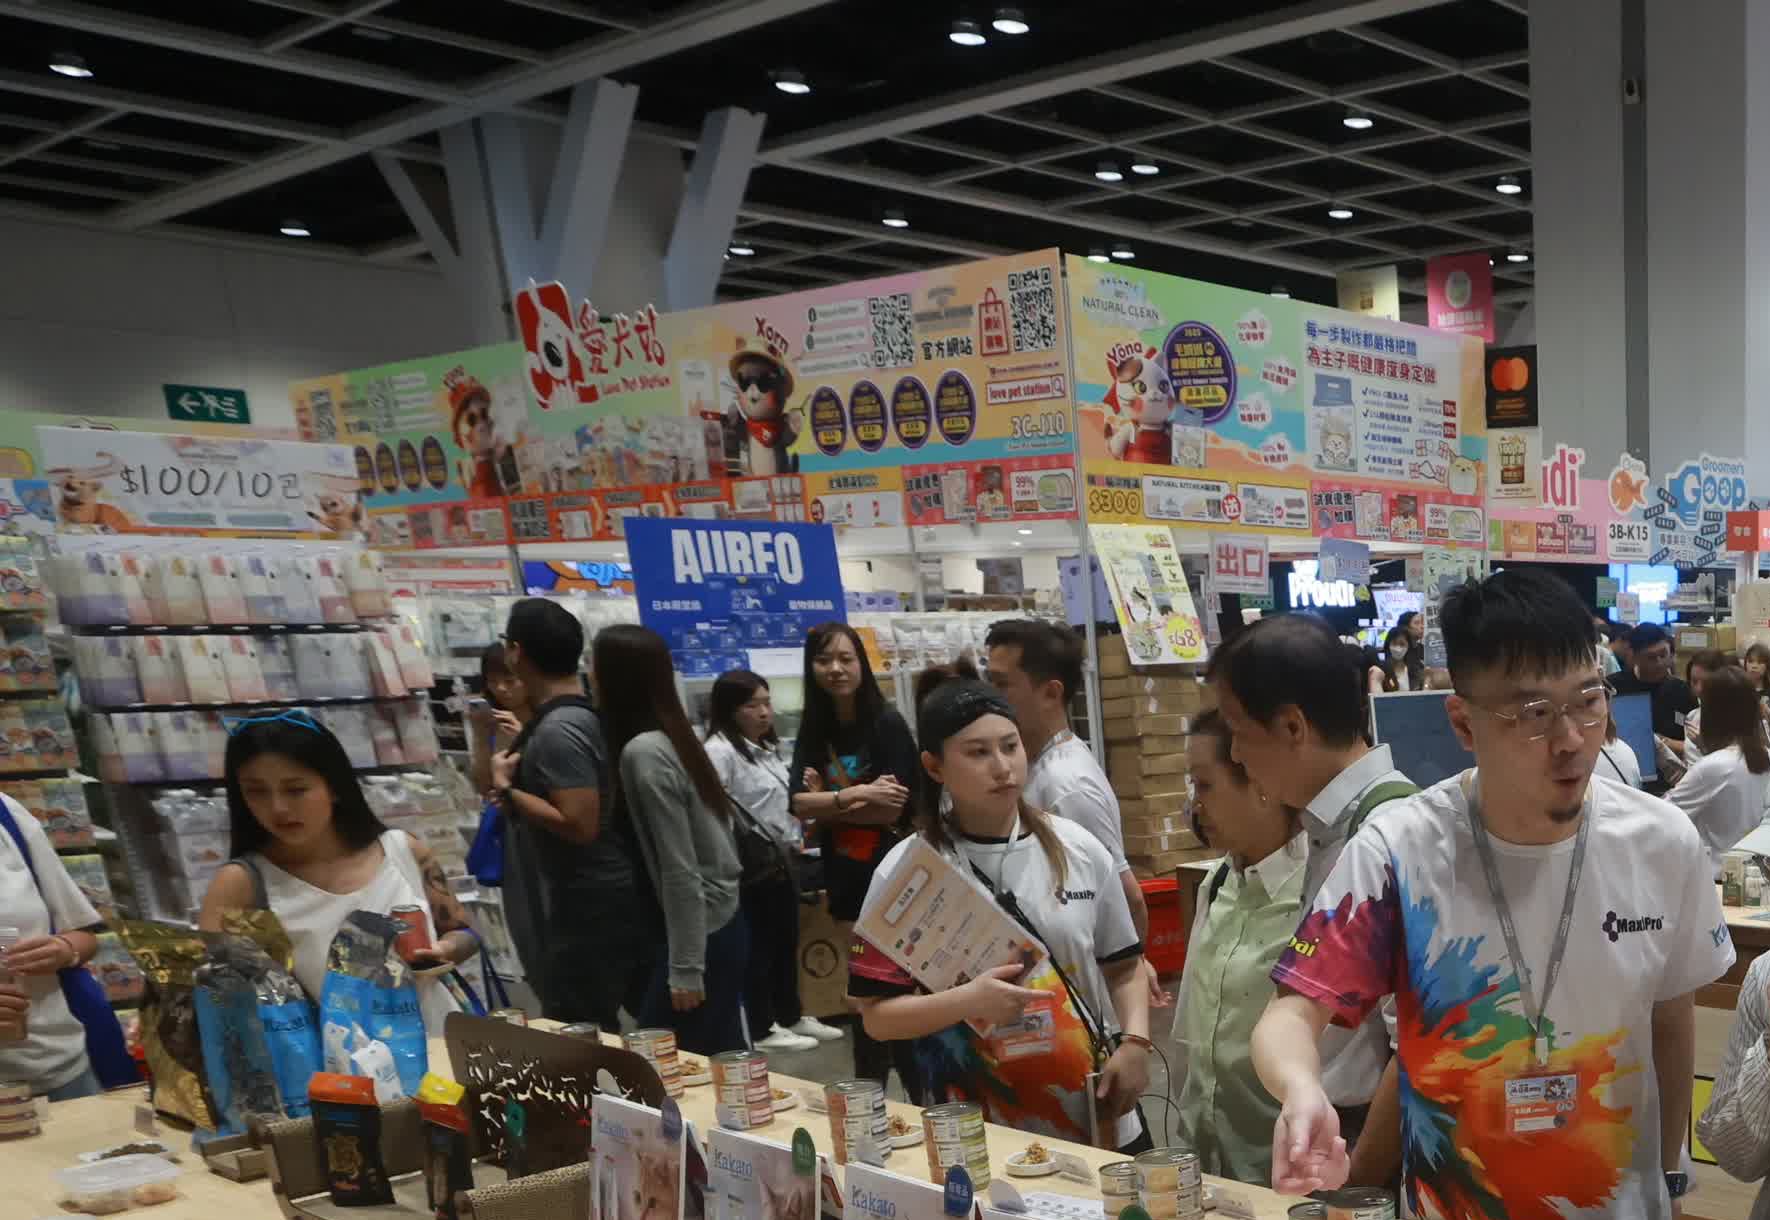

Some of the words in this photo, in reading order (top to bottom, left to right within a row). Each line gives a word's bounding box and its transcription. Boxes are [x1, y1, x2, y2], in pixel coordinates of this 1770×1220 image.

[1082, 296, 1126, 316] NATURAL
[1128, 303, 1160, 321] CLEAN
[1609, 522, 1649, 542] 3B-K15
[1215, 543, 1265, 578] 出口
[713, 1147, 753, 1178] Kakato
[850, 1184, 896, 1217] Kakato
